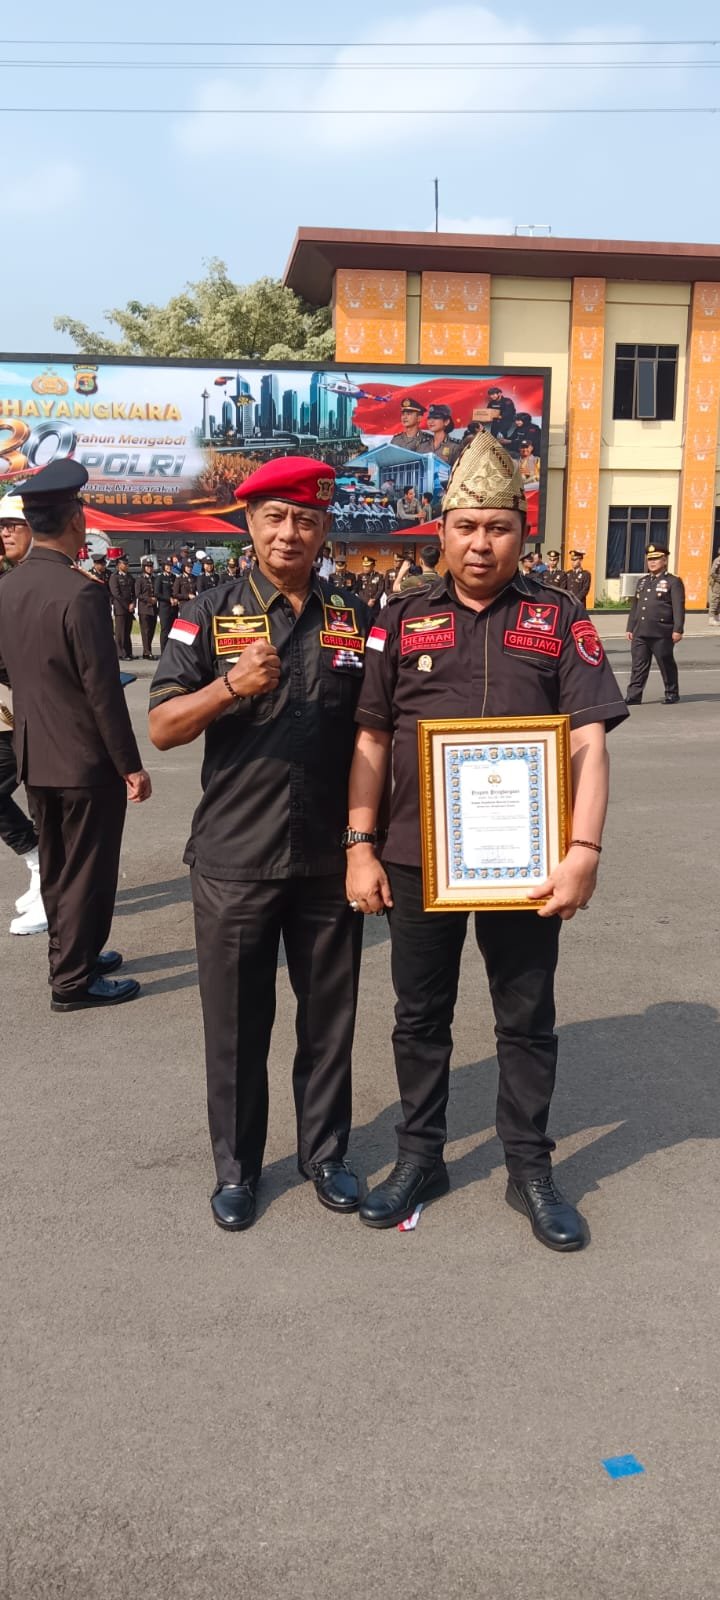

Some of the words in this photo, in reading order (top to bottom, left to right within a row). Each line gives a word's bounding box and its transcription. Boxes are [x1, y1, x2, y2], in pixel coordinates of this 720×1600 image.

[0, 400, 182, 421] HAYANGKARA
[77, 434, 115, 445] Tahun
[118, 435, 186, 446] Mengabdi
[80, 452, 186, 477] POLRI
[95, 493, 127, 504] Juli
[132, 493, 173, 505] 2026
[323, 635, 344, 646] GRIB
[344, 639, 361, 649] JAYA
[405, 633, 451, 646] HERMAN
[509, 634, 533, 647] GRIB
[533, 640, 557, 653] JAYA
